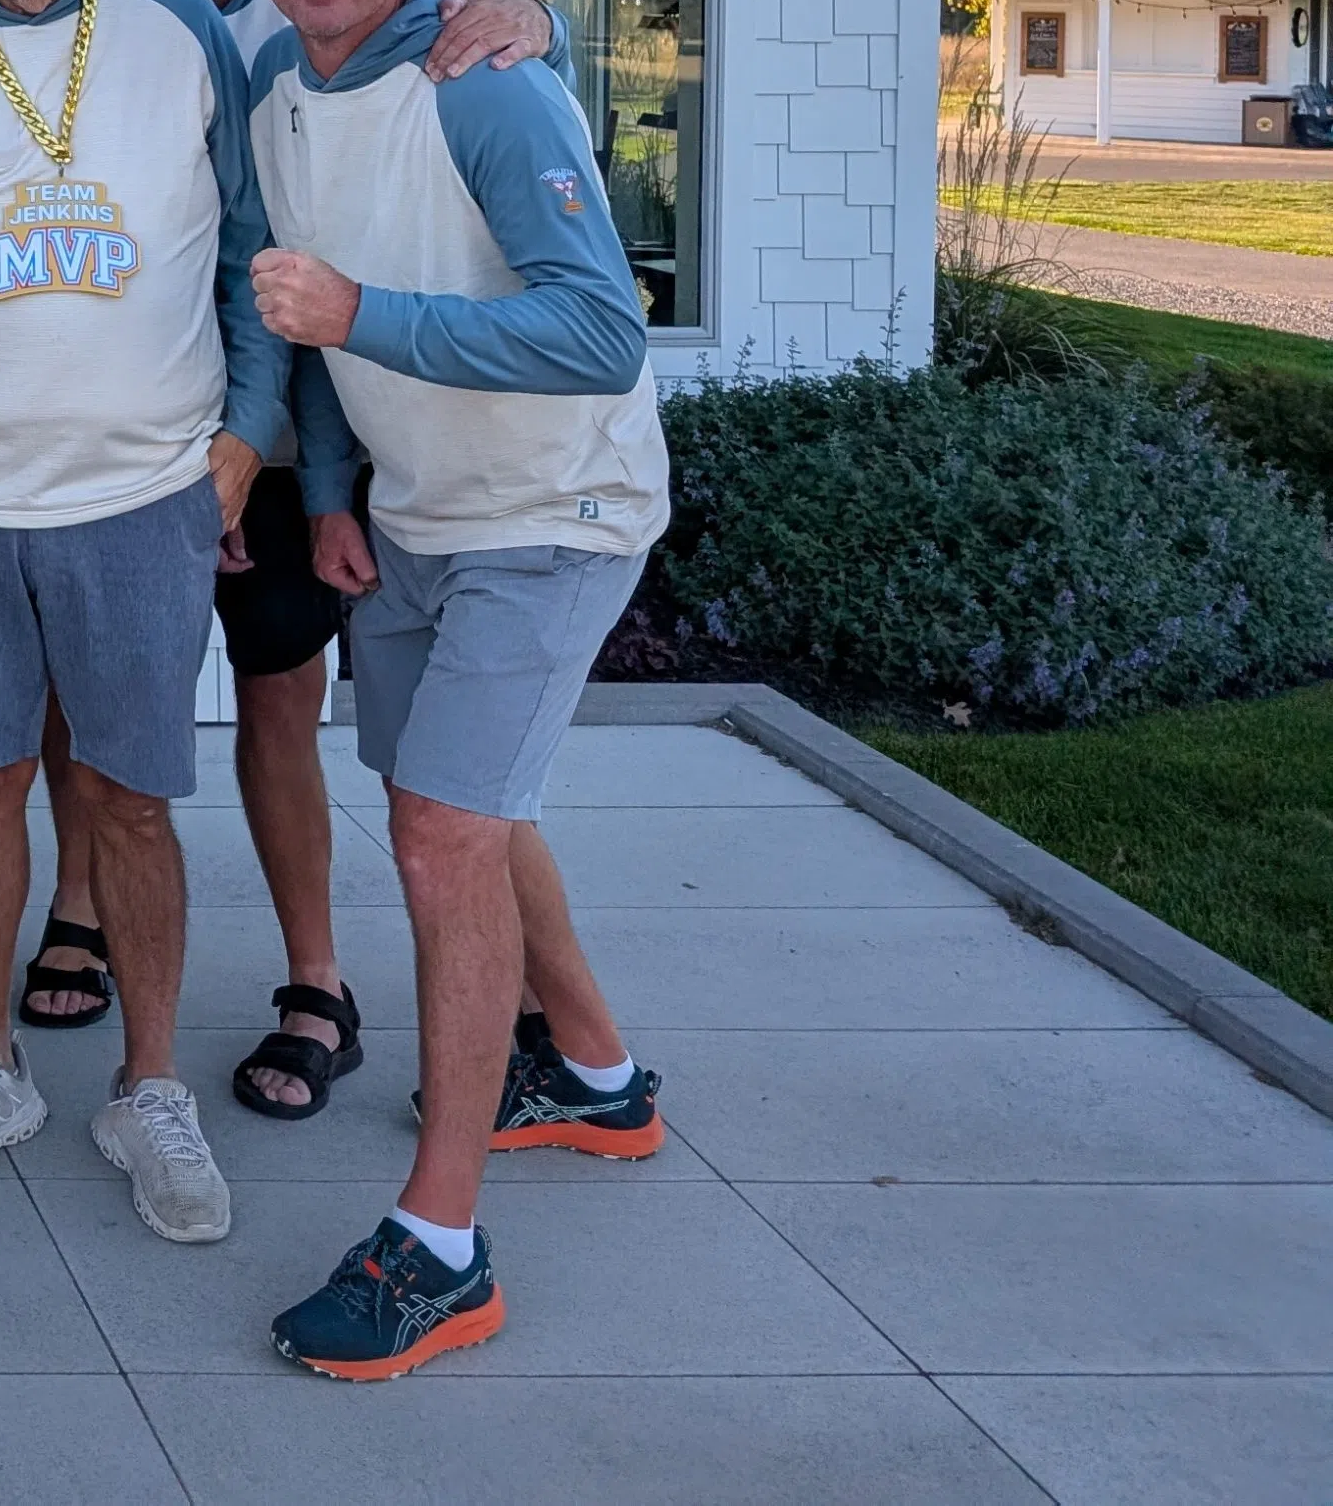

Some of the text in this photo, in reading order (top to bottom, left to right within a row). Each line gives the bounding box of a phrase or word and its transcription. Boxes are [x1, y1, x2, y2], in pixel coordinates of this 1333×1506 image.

[25, 184, 96, 203] TEAM
[9, 204, 114, 225] JENKINS
[579, 500, 599, 519] FJ
